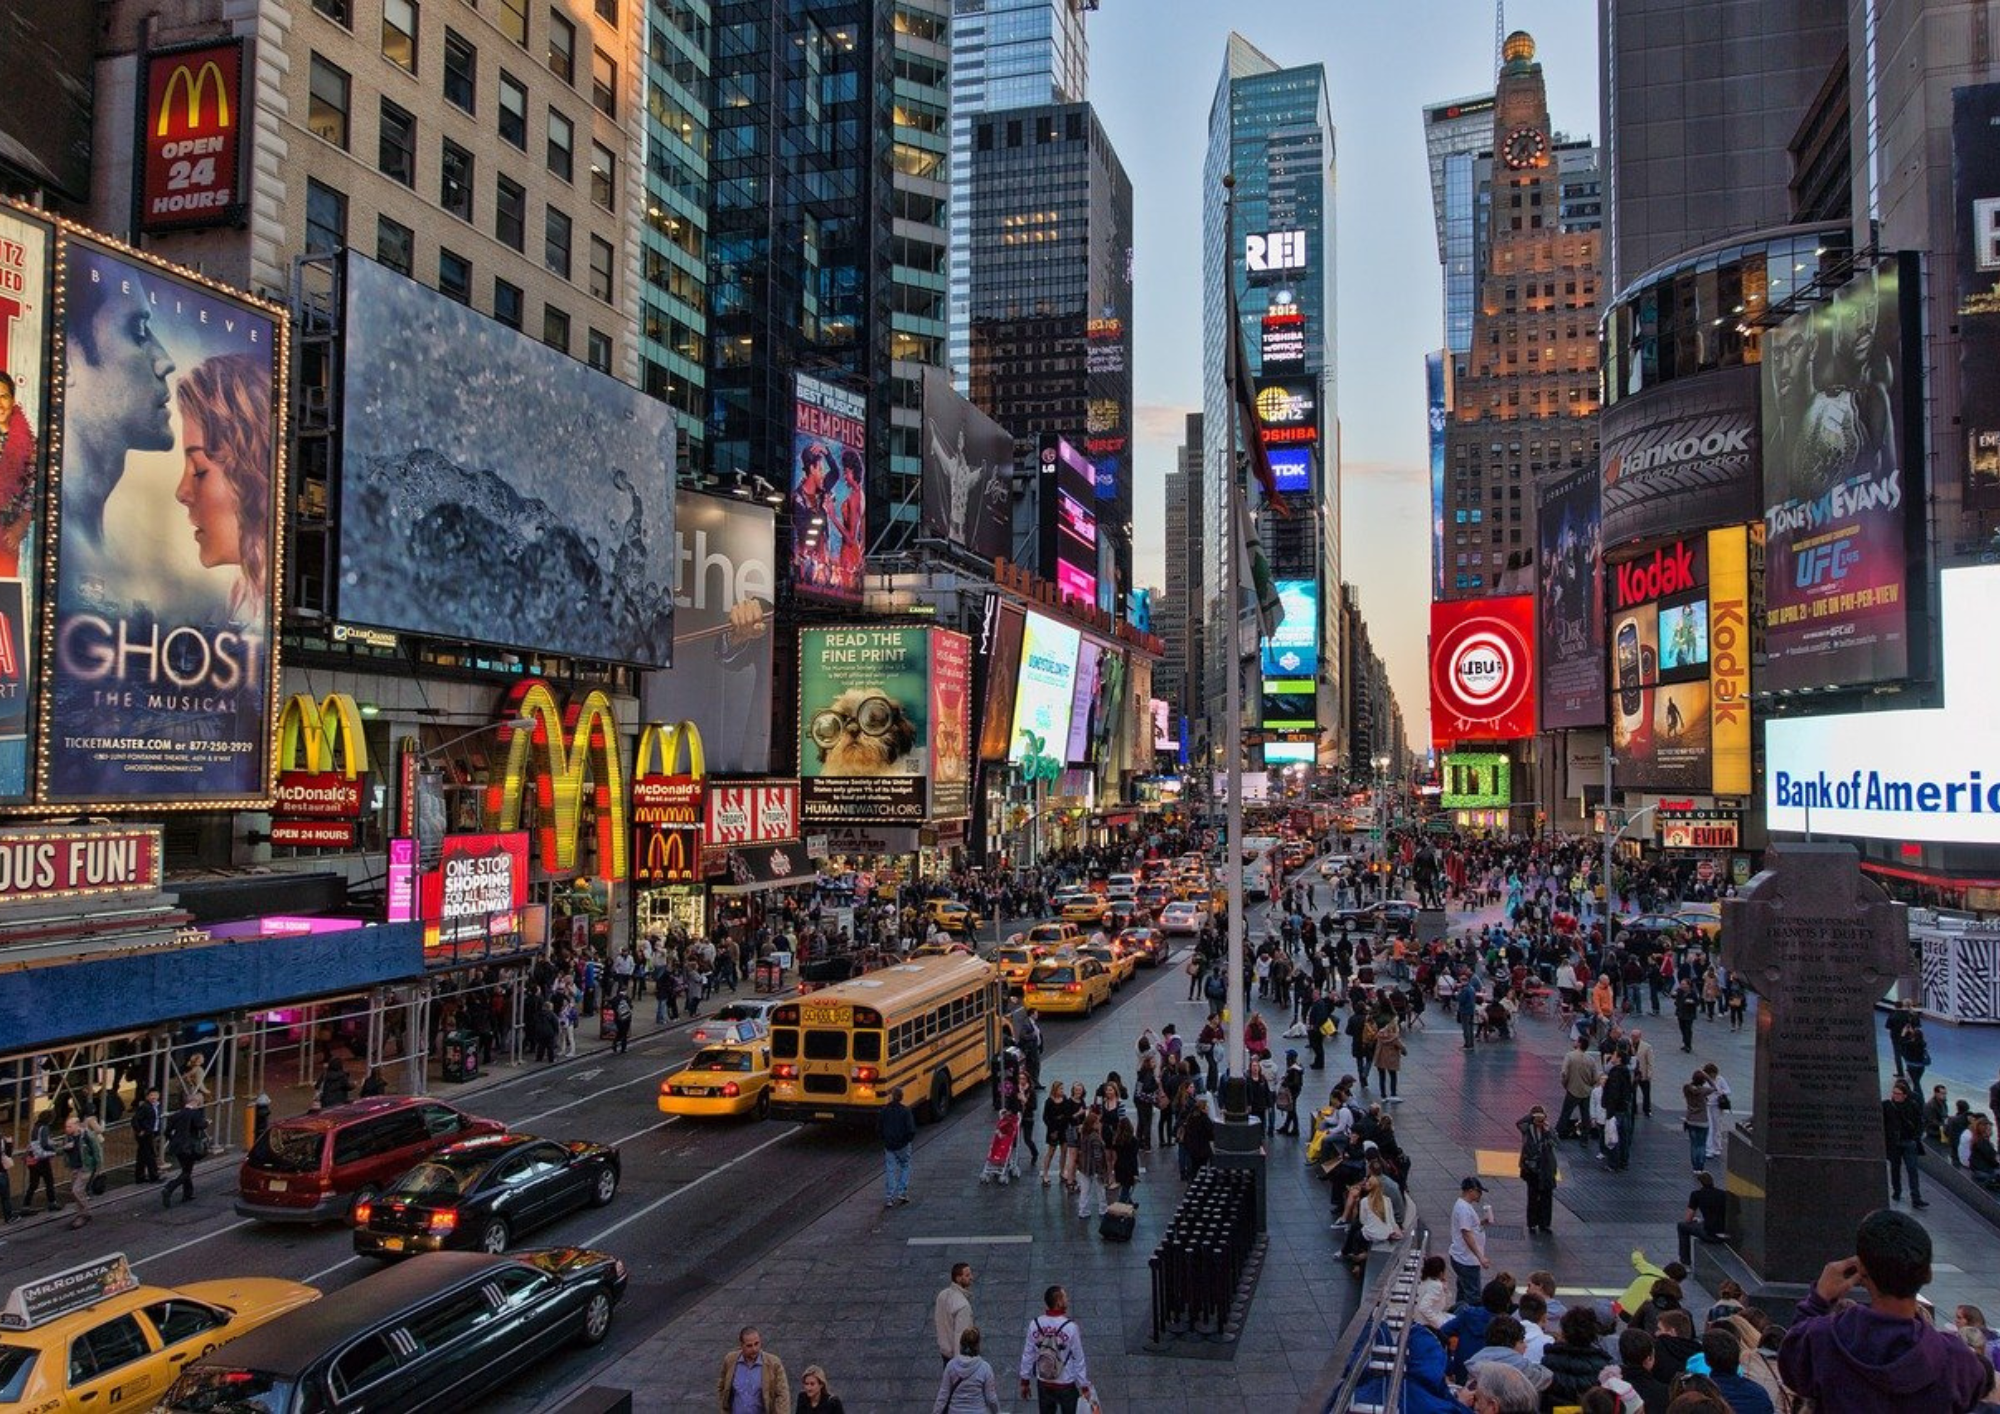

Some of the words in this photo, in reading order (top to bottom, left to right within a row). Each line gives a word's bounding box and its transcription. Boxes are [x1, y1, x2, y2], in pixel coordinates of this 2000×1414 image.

[162, 136, 224, 159] OPEN
[167, 158, 216, 189] 24
[152, 189, 229, 213] HOURS
[0, 241, 24, 267] TZ
[0, 268, 22, 291] ED
[91, 269, 259, 342] BELIEVE
[1269, 304, 1297, 317] 2012
[1263, 331, 1304, 342] TOSHIBA
[796, 384, 822, 405] BEST
[824, 395, 866, 421] MUSICAL
[1270, 409, 1304, 421] 2012
[796, 403, 865, 449] MEMPHIS
[1261, 427, 1317, 441] OSHIBA
[1272, 464, 1306, 477] TDK
[1633, 463, 1674, 484] driving
[1677, 453, 1749, 472] emotion
[1765, 500, 1812, 540] JONES
[1831, 469, 1902, 518] EVANS
[675, 529, 775, 613] the
[1617, 541, 1695, 606] Kodak
[1796, 540, 1851, 587] UFC
[1780, 605, 1799, 624] APRIL
[1812, 599, 1828, 617] LIVE
[1828, 596, 1839, 614] ON
[1840, 583, 1899, 612] PAY-PER-VIEW
[826, 634, 868, 647] READ
[872, 632, 902, 645] THE
[58, 613, 263, 690] GHOST
[821, 649, 856, 662] FINE
[861, 648, 907, 662] PRINT
[1713, 600, 1745, 726] Kodak
[93, 691, 132, 708] THE
[148, 694, 237, 714] MUSICAL
[64, 737, 171, 750] TICKETMASTER.COM
[175, 743, 186, 751] or
[189, 741, 253, 752] 877-250-2929
[634, 783, 702, 795] McDonald's
[851, 778, 873, 786] Society
[1776, 770, 1832, 808] Bank
[1836, 770, 1862, 809] of
[276, 786, 357, 801] McDonald's
[283, 802, 342, 811] Restaurant
[805, 804, 923, 815] HUMANEWATCH.ORG
[1662, 811, 1739, 819] MARQUIS
[271, 828, 299, 838] OPEN
[301, 830, 313, 838] 24
[315, 830, 349, 839] HOURS
[1691, 827, 1735, 847] EVITA
[69, 839, 137, 886] FUN!
[446, 859, 475, 877] ONE
[477, 856, 510, 874] STOP
[444, 872, 510, 893] SHOPPING
[445, 893, 463, 903] FOR
[464, 889, 479, 901] ALL
[480, 886, 509, 900] THINGS
[443, 897, 511, 917] BROADWAY
[1766, 928, 1817, 938] FRANCIS
